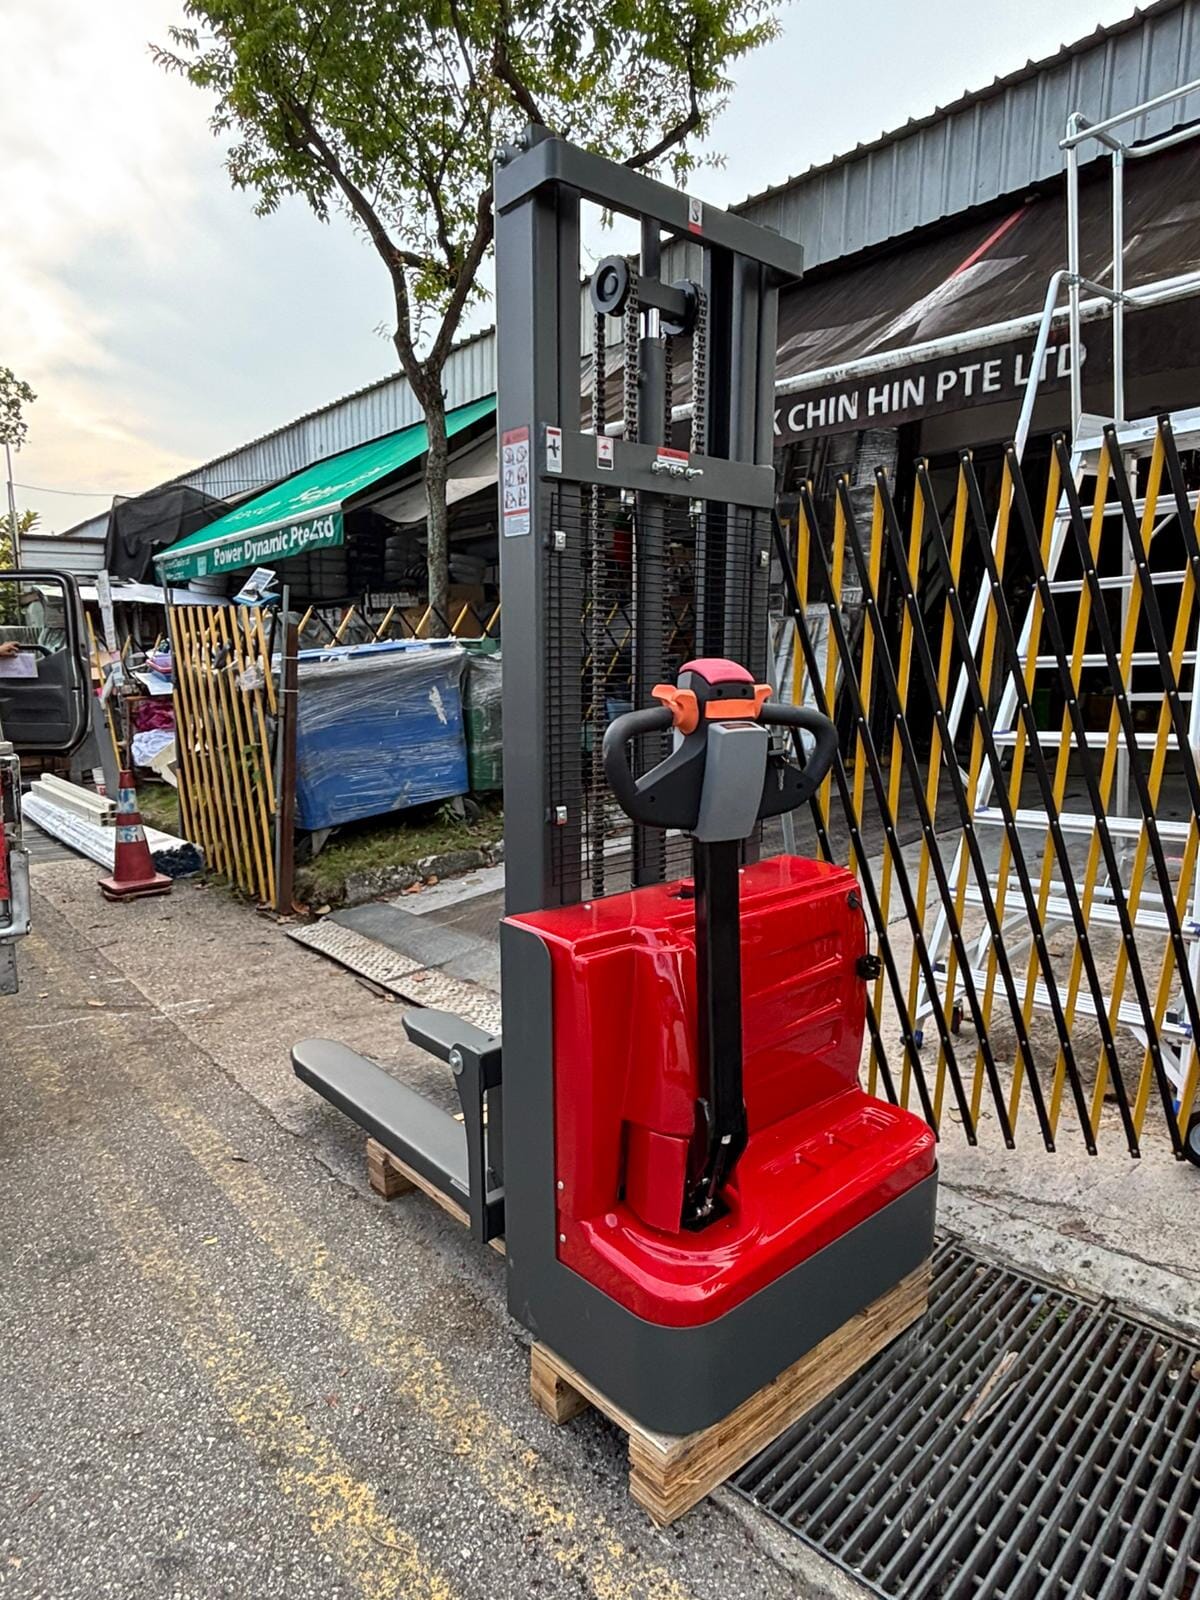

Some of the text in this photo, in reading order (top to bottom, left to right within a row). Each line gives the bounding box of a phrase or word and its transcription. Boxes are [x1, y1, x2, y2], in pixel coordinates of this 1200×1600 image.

[787, 390, 859, 432] CHIN
[867, 375, 926, 417] HIN
[935, 359, 1002, 402] PTE
[1013, 342, 1088, 387] LTD
[213, 546, 243, 567] Power
[244, 530, 289, 563] Dynamic
